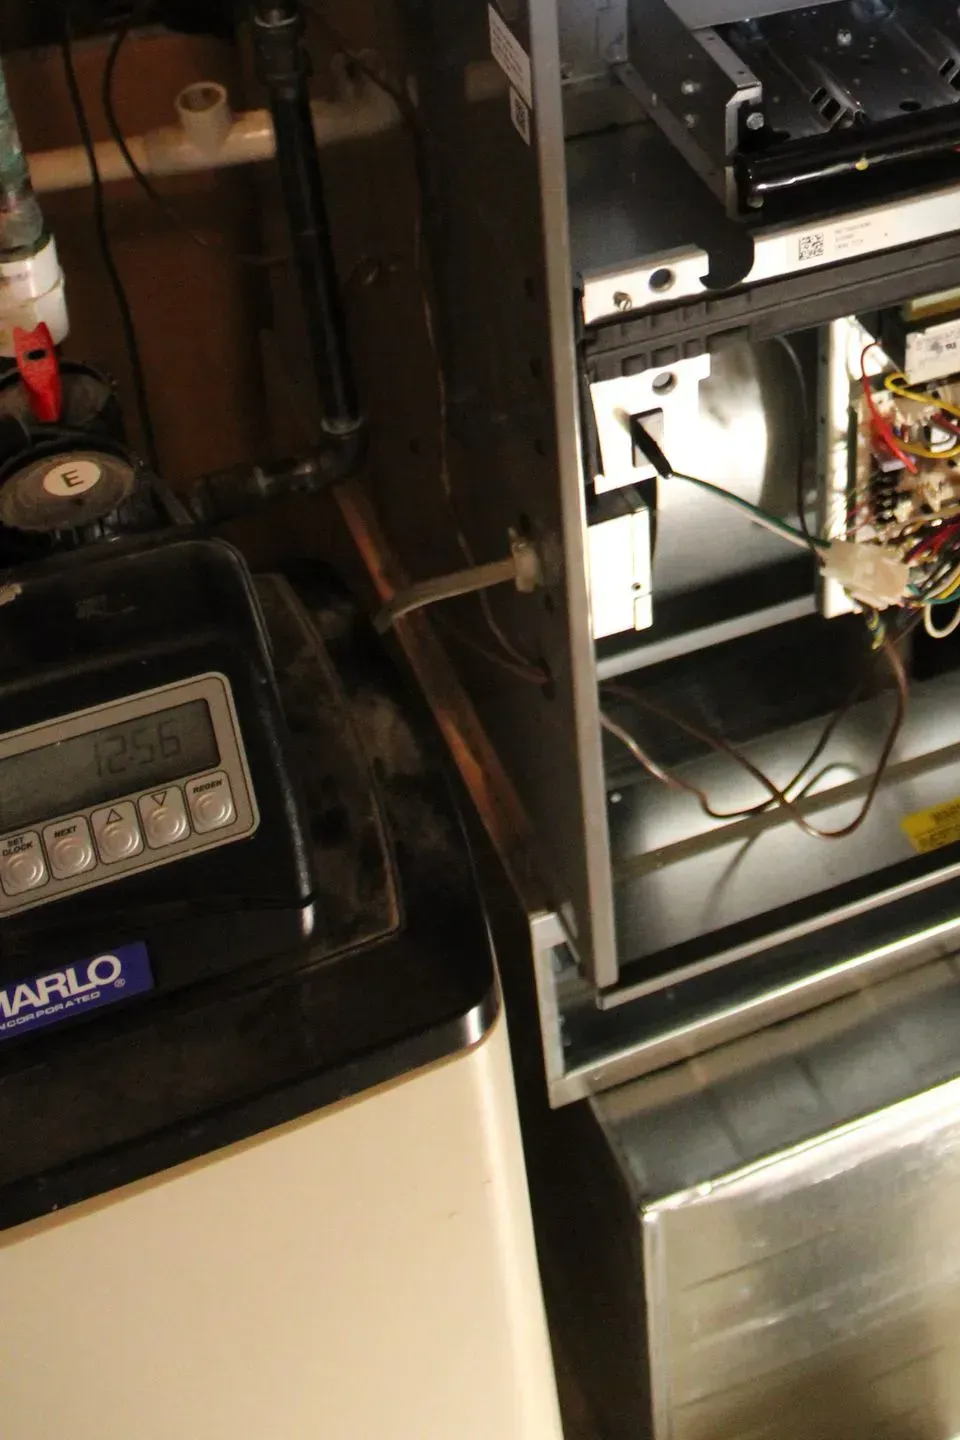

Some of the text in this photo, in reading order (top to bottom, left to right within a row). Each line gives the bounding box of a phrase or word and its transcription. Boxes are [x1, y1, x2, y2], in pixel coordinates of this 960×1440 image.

[60, 469, 84, 488] E
[192, 778, 223, 794] REGEN
[53, 824, 79, 839] NEXT
[2, 840, 33, 857] CLOCK
[7, 836, 25, 848] SET
